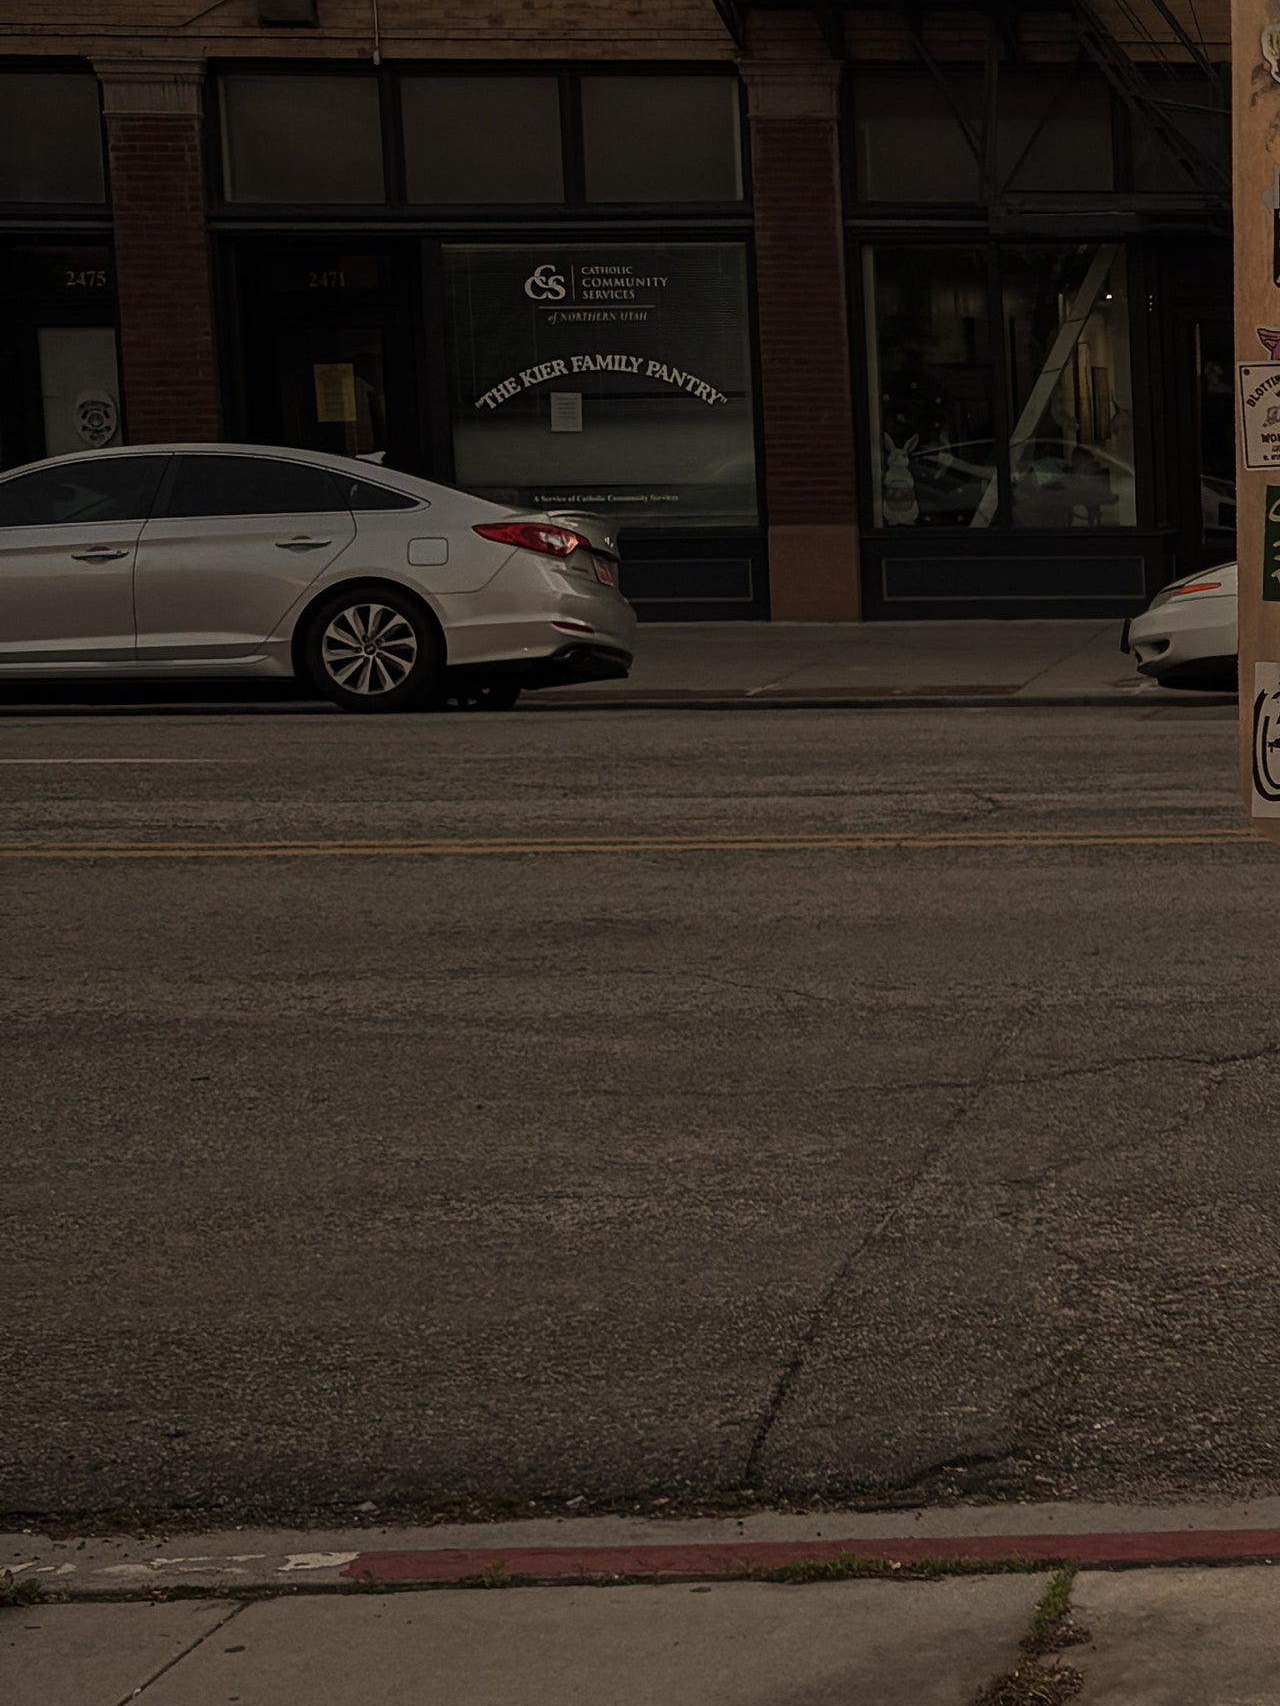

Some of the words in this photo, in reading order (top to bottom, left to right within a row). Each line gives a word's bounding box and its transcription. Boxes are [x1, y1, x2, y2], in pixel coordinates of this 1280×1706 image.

[580, 265, 633, 275] CATHOLIC
[65, 270, 107, 287] 2475
[308, 271, 346, 288] 2471
[581, 276, 669, 288] COMMUNITY
[581, 289, 636, 300] SERVICES
[559, 311, 617, 323] NORTHERN
[619, 310, 648, 322] UTAH
[518, 358, 569, 388] KIER
[570, 353, 644, 374] FAMILY
